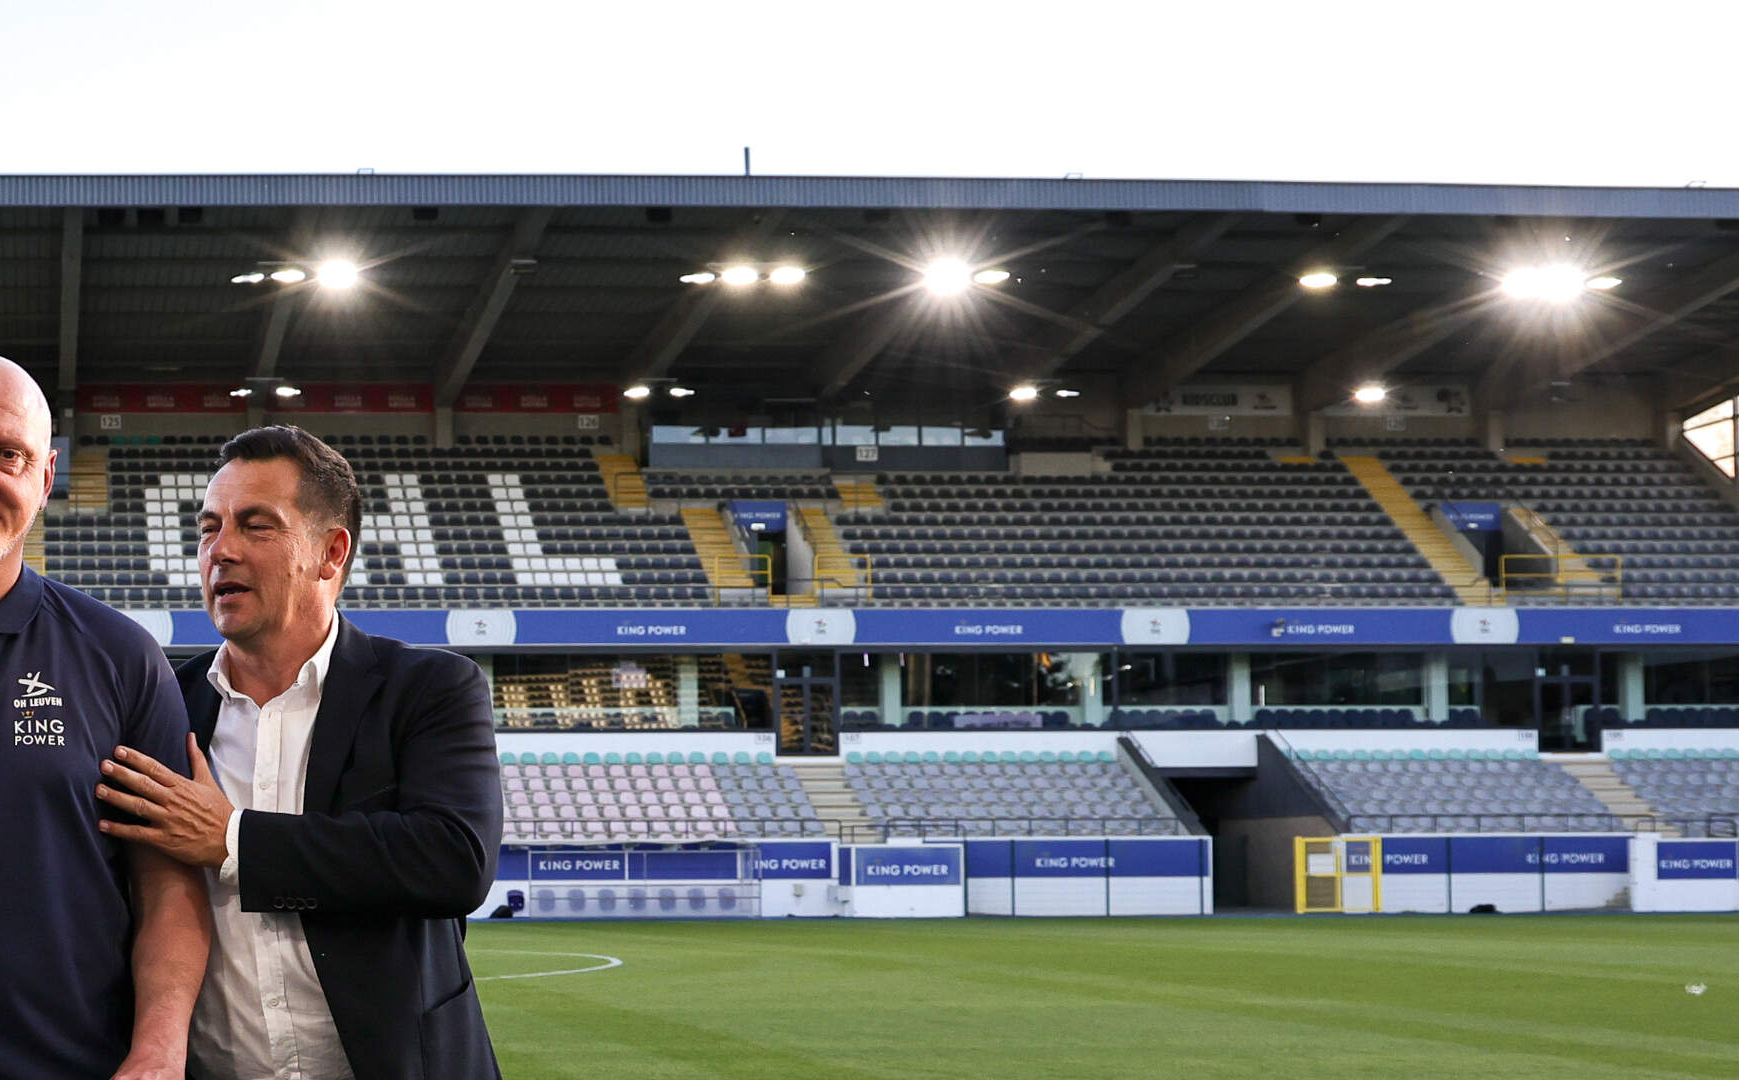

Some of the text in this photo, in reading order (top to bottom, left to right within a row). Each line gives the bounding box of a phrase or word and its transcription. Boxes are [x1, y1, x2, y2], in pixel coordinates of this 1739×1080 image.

[617, 626, 686, 636] KING POWER
[13, 697, 63, 708] OH LEUVEN
[14, 719, 64, 734] KING
[14, 734, 65, 746] POWER
[755, 859, 826, 871] ING POWER
[1350, 854, 1372, 865] KIN
[539, 860, 620, 871] KING POWER
[867, 864, 949, 876] KING POWER
